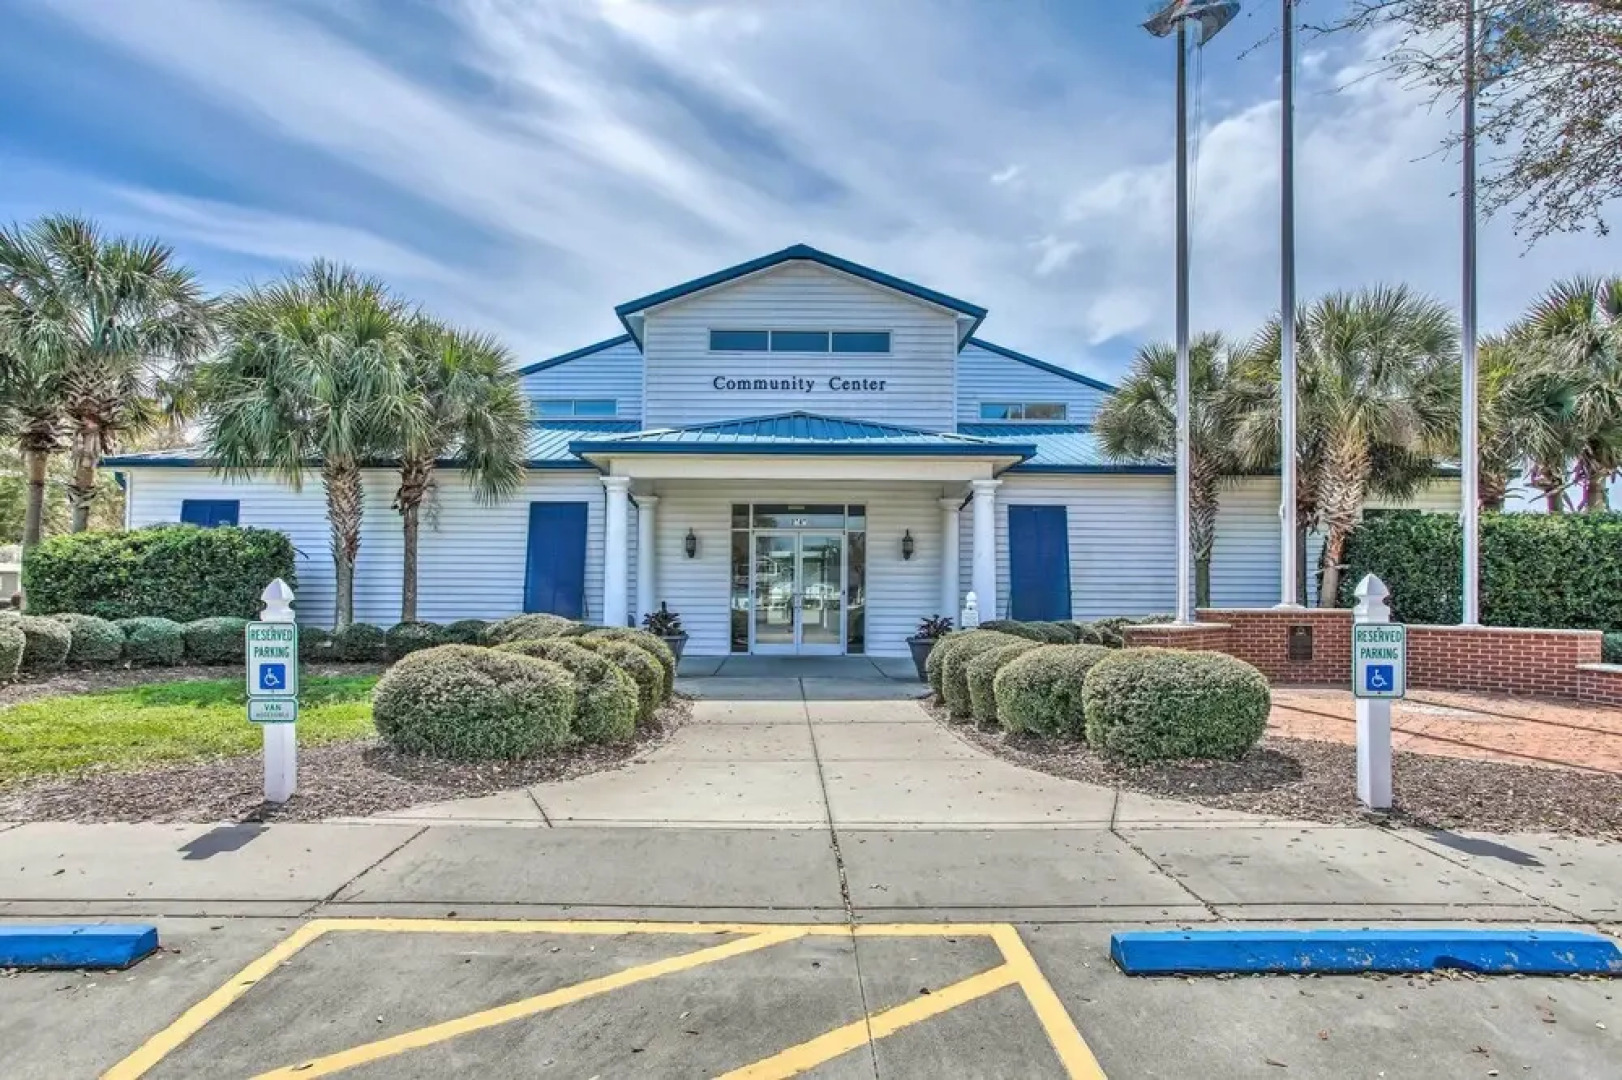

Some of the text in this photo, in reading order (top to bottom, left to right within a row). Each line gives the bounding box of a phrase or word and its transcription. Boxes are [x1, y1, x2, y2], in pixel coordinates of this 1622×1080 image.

[713, 376, 887, 393] Community Center
[250, 629, 293, 641] RESERVED
[1357, 630, 1402, 642] RESERVED
[254, 646, 290, 658] PARKING
[1360, 647, 1399, 659] PARKING
[263, 703, 281, 711] VAN
